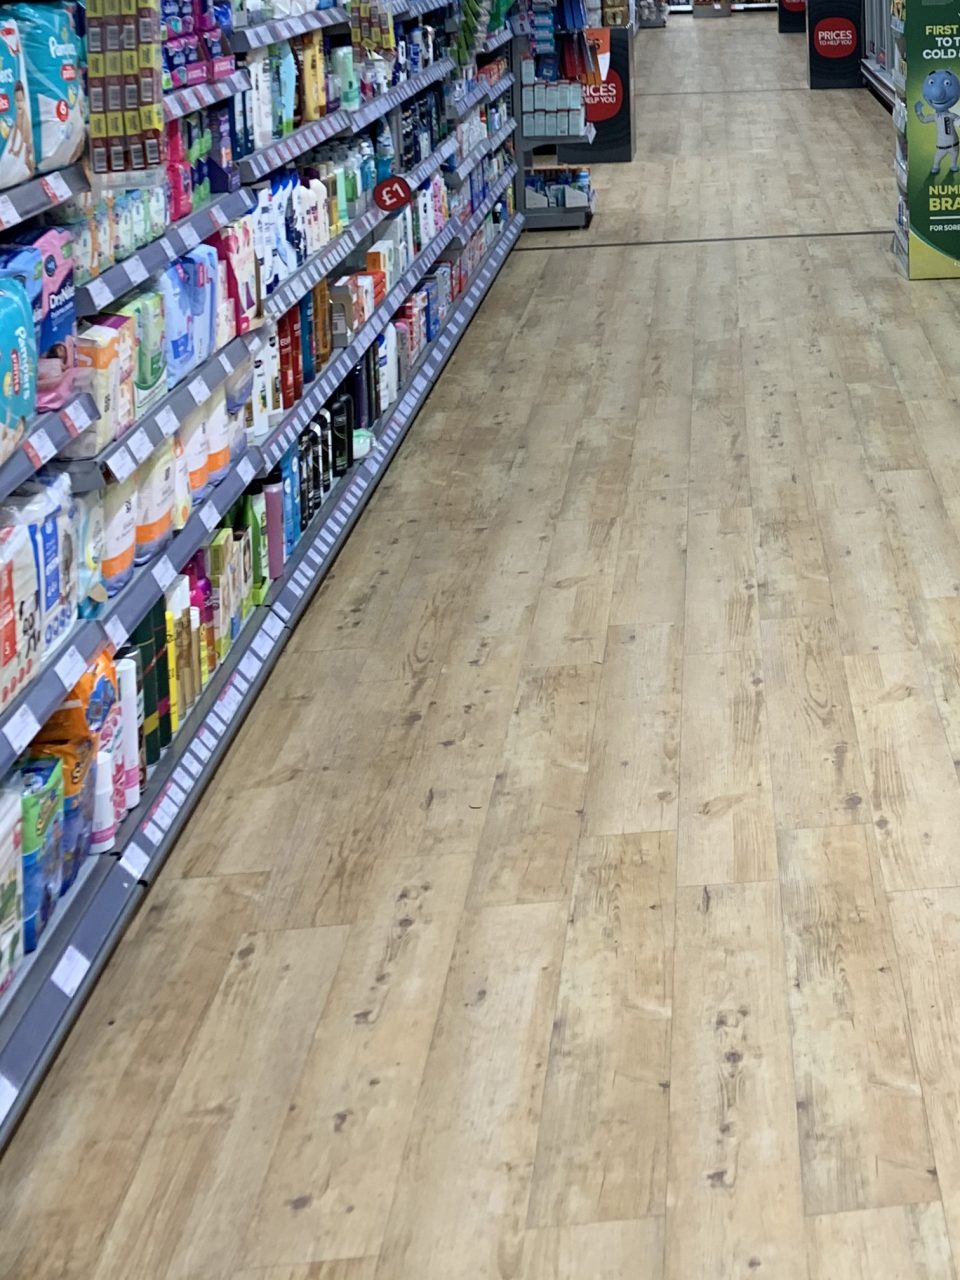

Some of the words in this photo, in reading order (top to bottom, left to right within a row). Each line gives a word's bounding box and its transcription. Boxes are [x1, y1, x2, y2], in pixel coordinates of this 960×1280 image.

[818, 30, 852, 41] PRICES
[925, 25, 959, 36] FIRST
[935, 37, 953, 48] TO
[923, 48, 957, 60] COLD
[601, 96, 617, 104] YOU
[380, 182, 405, 206] £1
[929, 224, 941, 232] FOR
